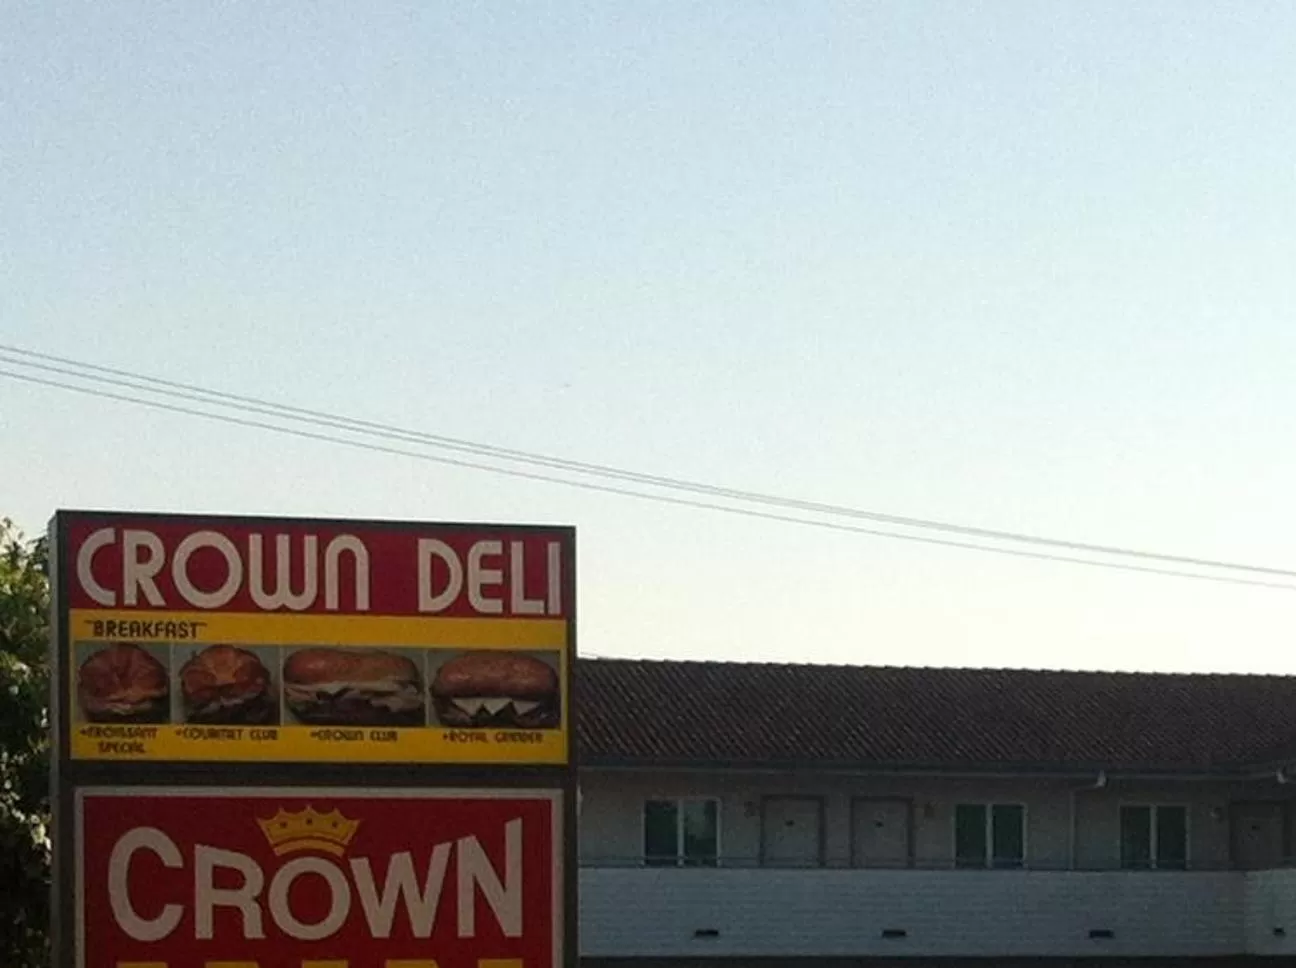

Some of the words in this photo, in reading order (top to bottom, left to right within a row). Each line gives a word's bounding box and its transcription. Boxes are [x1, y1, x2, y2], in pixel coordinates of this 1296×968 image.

[77, 527, 370, 610] CROWN
[417, 537, 561, 616] DELI
[108, 817, 523, 941] CROWN
